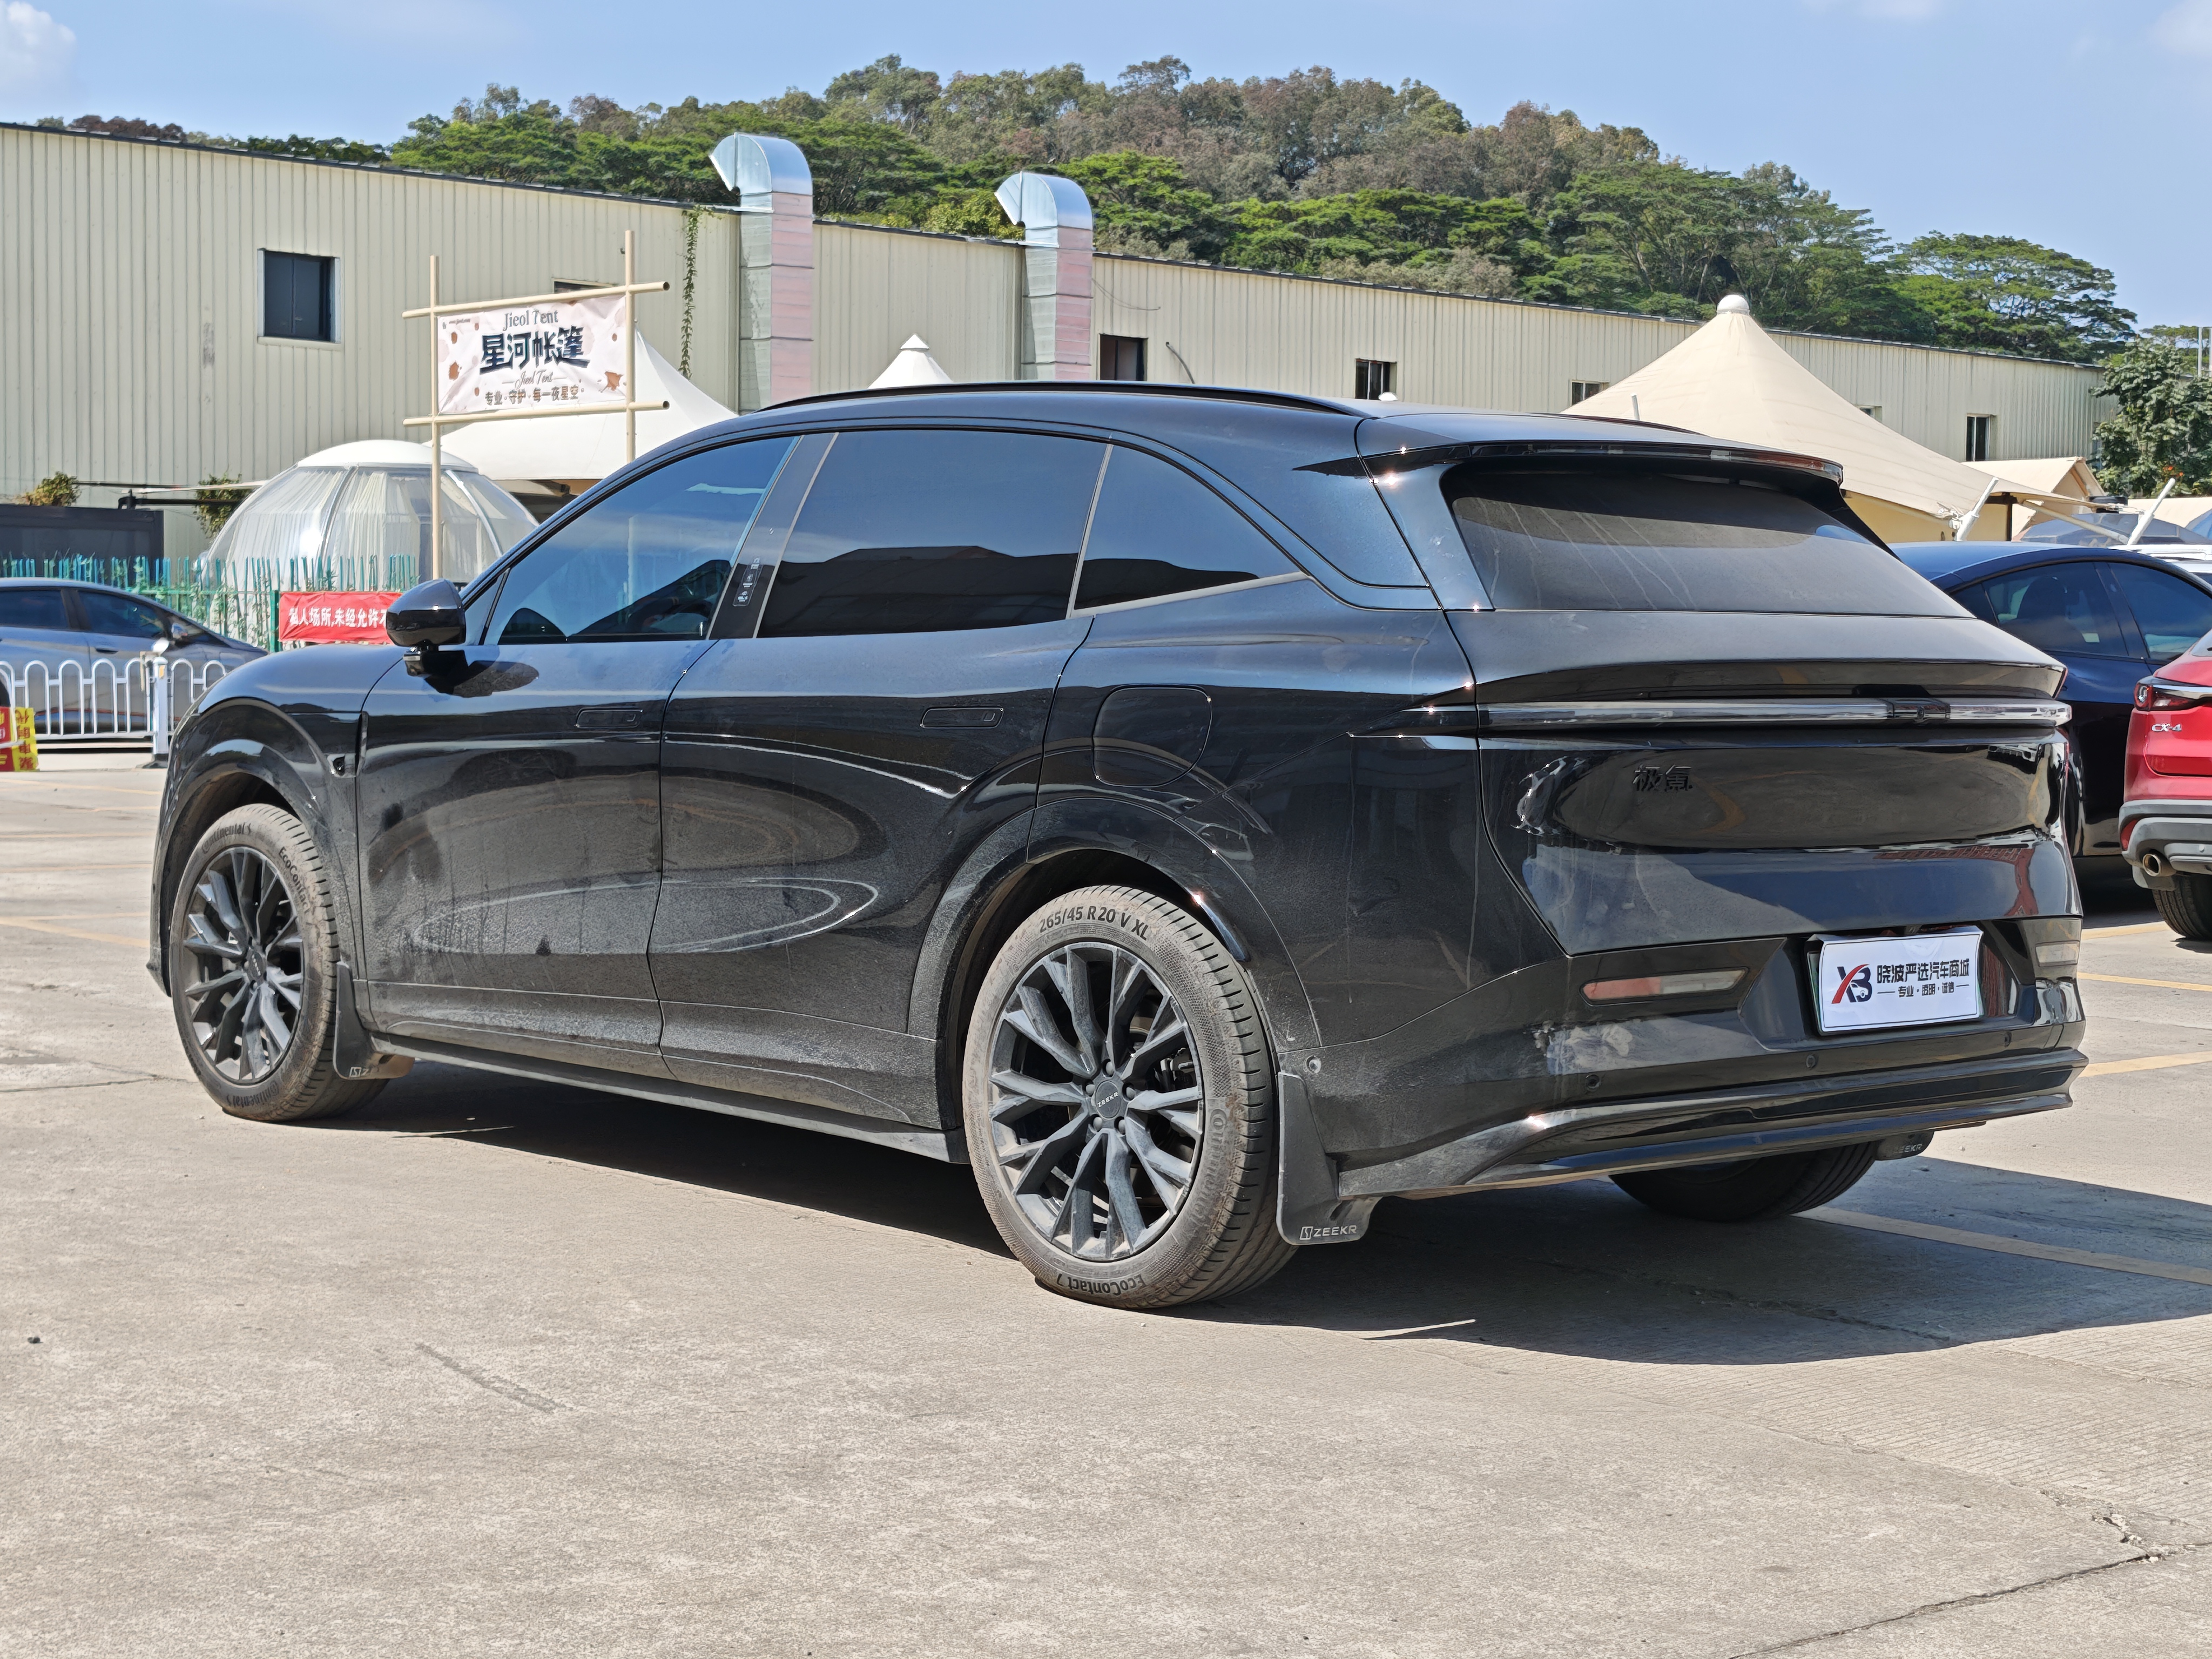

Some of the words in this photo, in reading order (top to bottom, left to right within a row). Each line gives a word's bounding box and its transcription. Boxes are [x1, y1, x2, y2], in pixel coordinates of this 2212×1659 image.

[531, 309, 558, 325] Tent
[480, 325, 590, 375] 星河帐篷
[2152, 723, 2182, 733] CX-4
[1633, 763, 1694, 792] 极氪
[1039, 906, 1083, 933] 265/45
[1120, 911, 1132, 928] V
[1131, 919, 1151, 941] XL
[1877, 958, 1970, 984] 晓波严选汽车商城
[1096, 1091, 1119, 1108] ZEEKR
[1312, 1224, 1358, 1238] ZEEKR
[1056, 1272, 1064, 1286] 7
[1067, 1273, 1147, 1296] EcoContact
